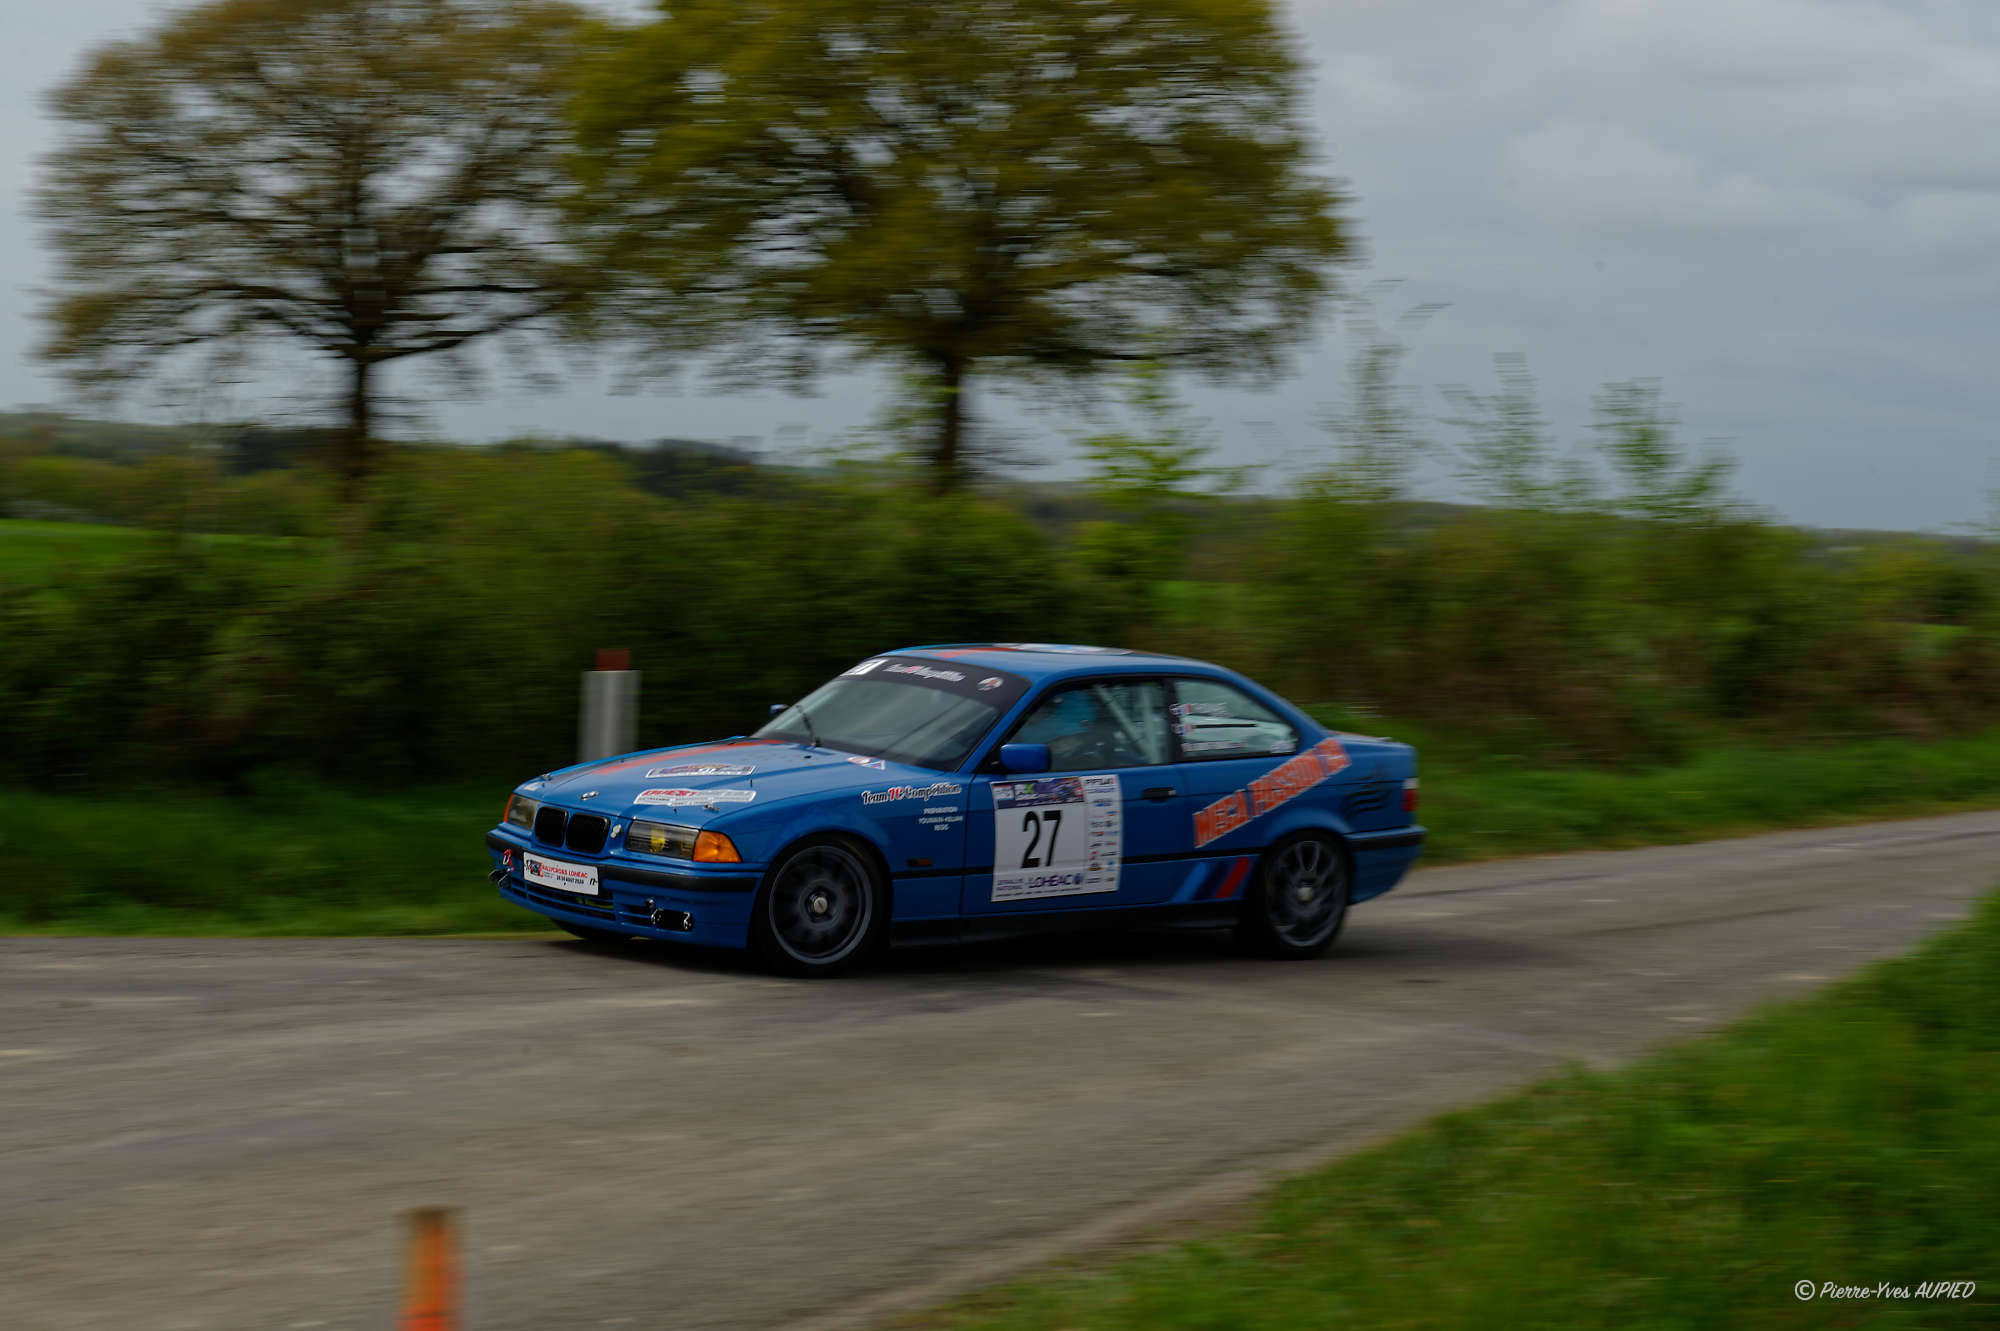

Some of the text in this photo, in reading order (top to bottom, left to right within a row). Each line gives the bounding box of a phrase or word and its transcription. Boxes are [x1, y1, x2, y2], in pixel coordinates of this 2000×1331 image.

[862, 790, 889, 805] Team
[1192, 788, 1252, 848] MEGA
[1021, 810, 1062, 868] 27
[1027, 874, 1073, 889] LOHEAC
